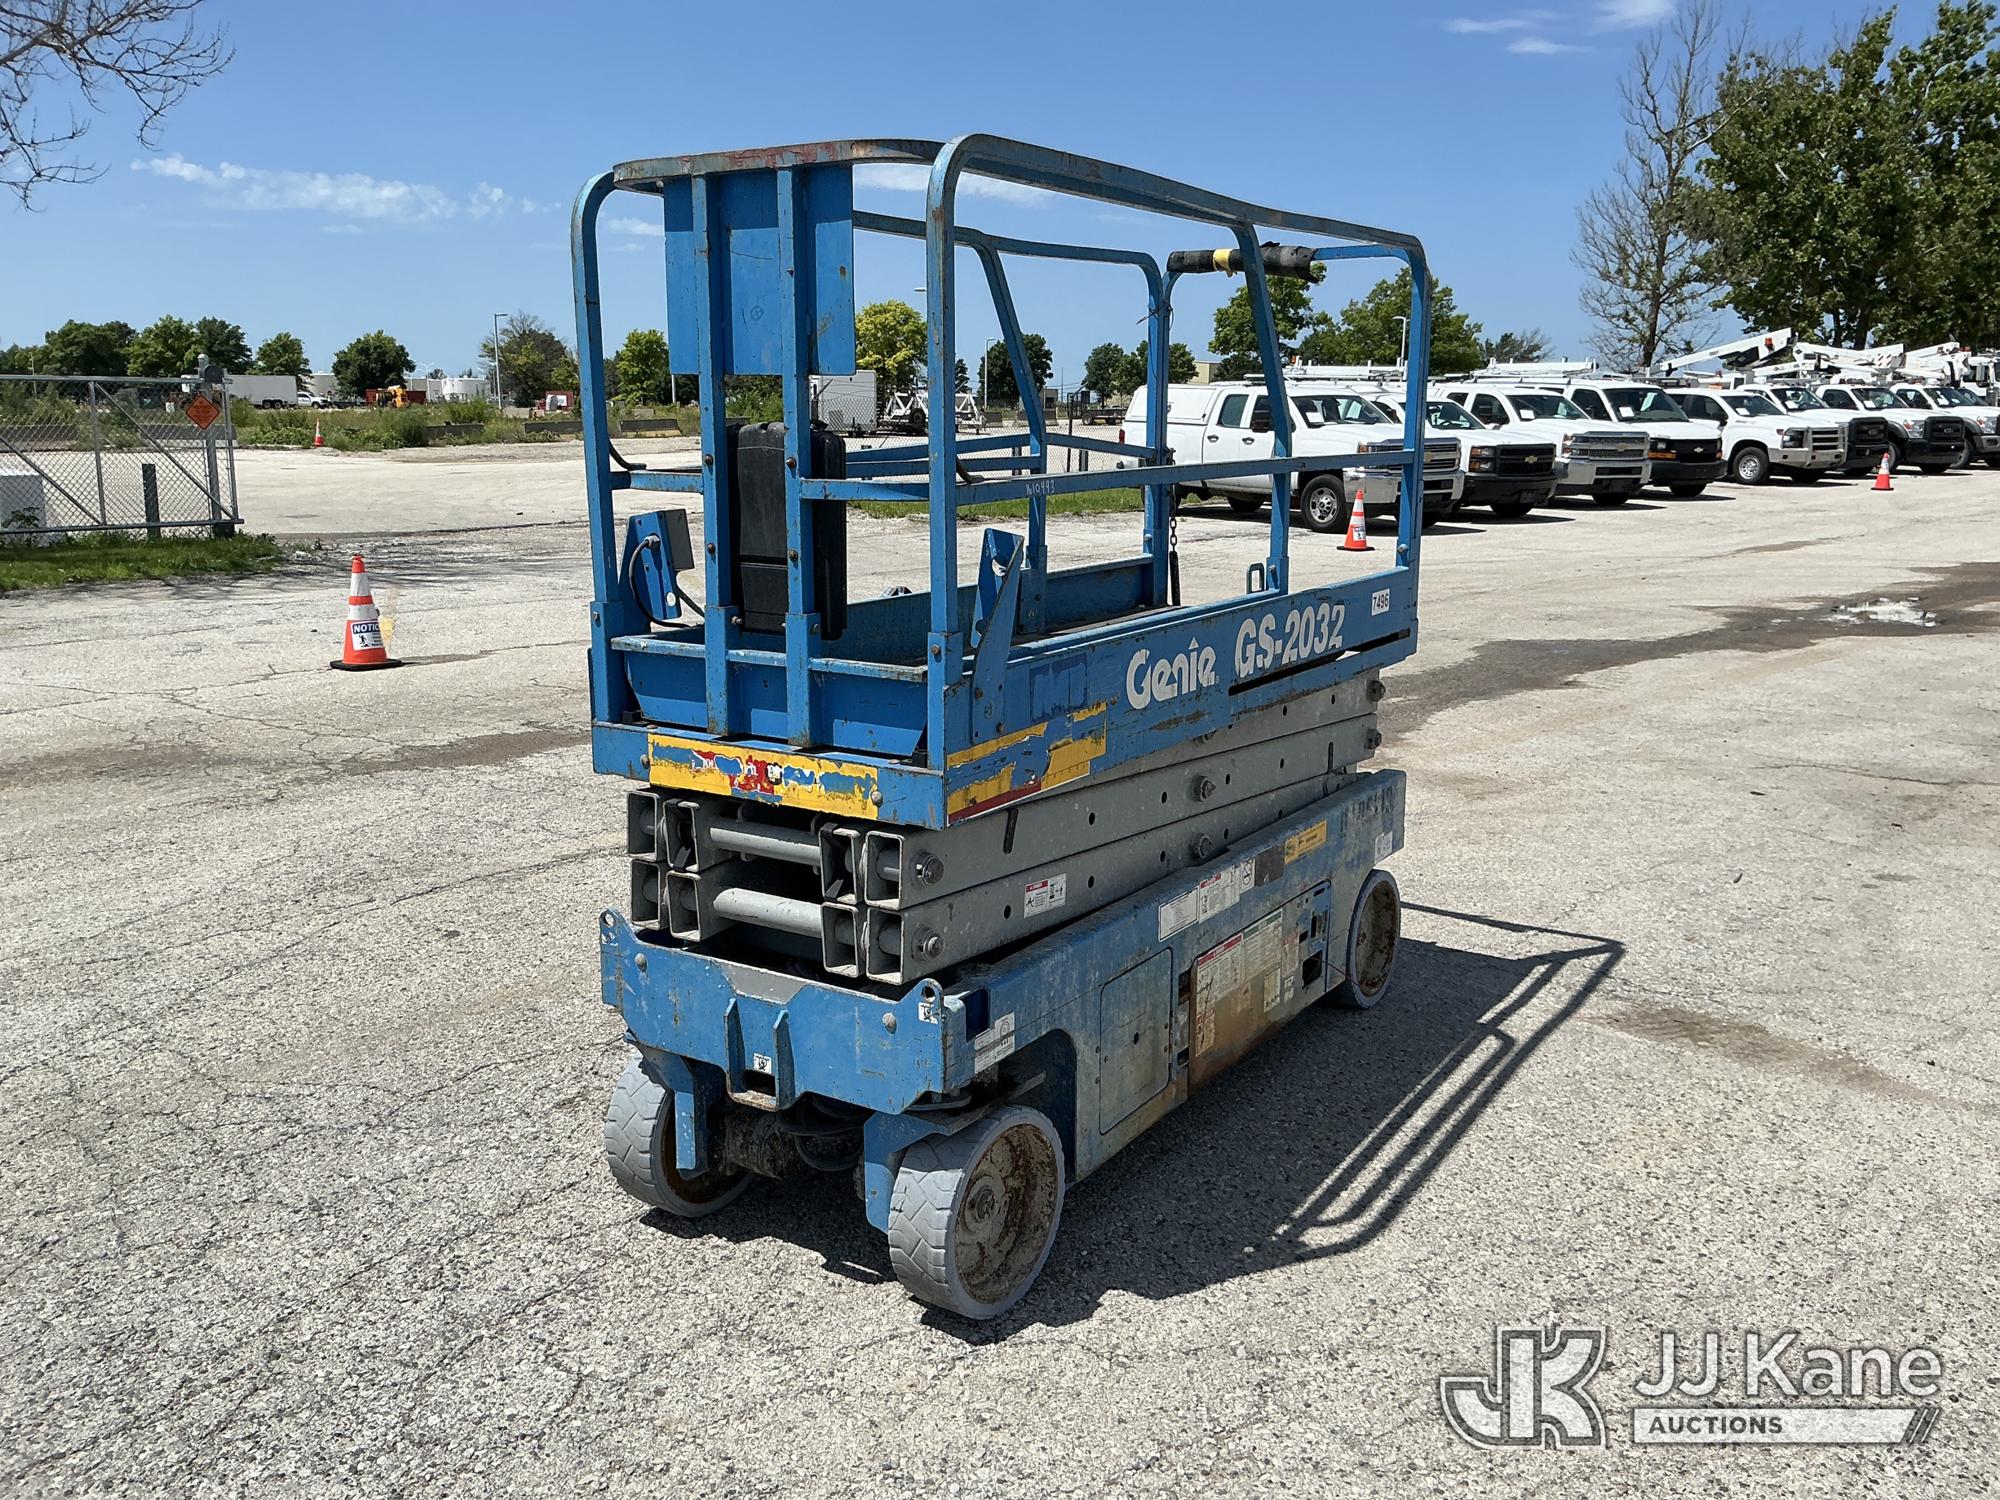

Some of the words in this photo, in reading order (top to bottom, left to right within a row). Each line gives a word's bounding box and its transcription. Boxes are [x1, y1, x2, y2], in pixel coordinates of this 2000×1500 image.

[1373, 593, 1389, 611] 7496
[353, 623, 380, 633] NOTIC
[1126, 637, 1217, 709] Genie
[1235, 602, 1345, 678] GS-2032
